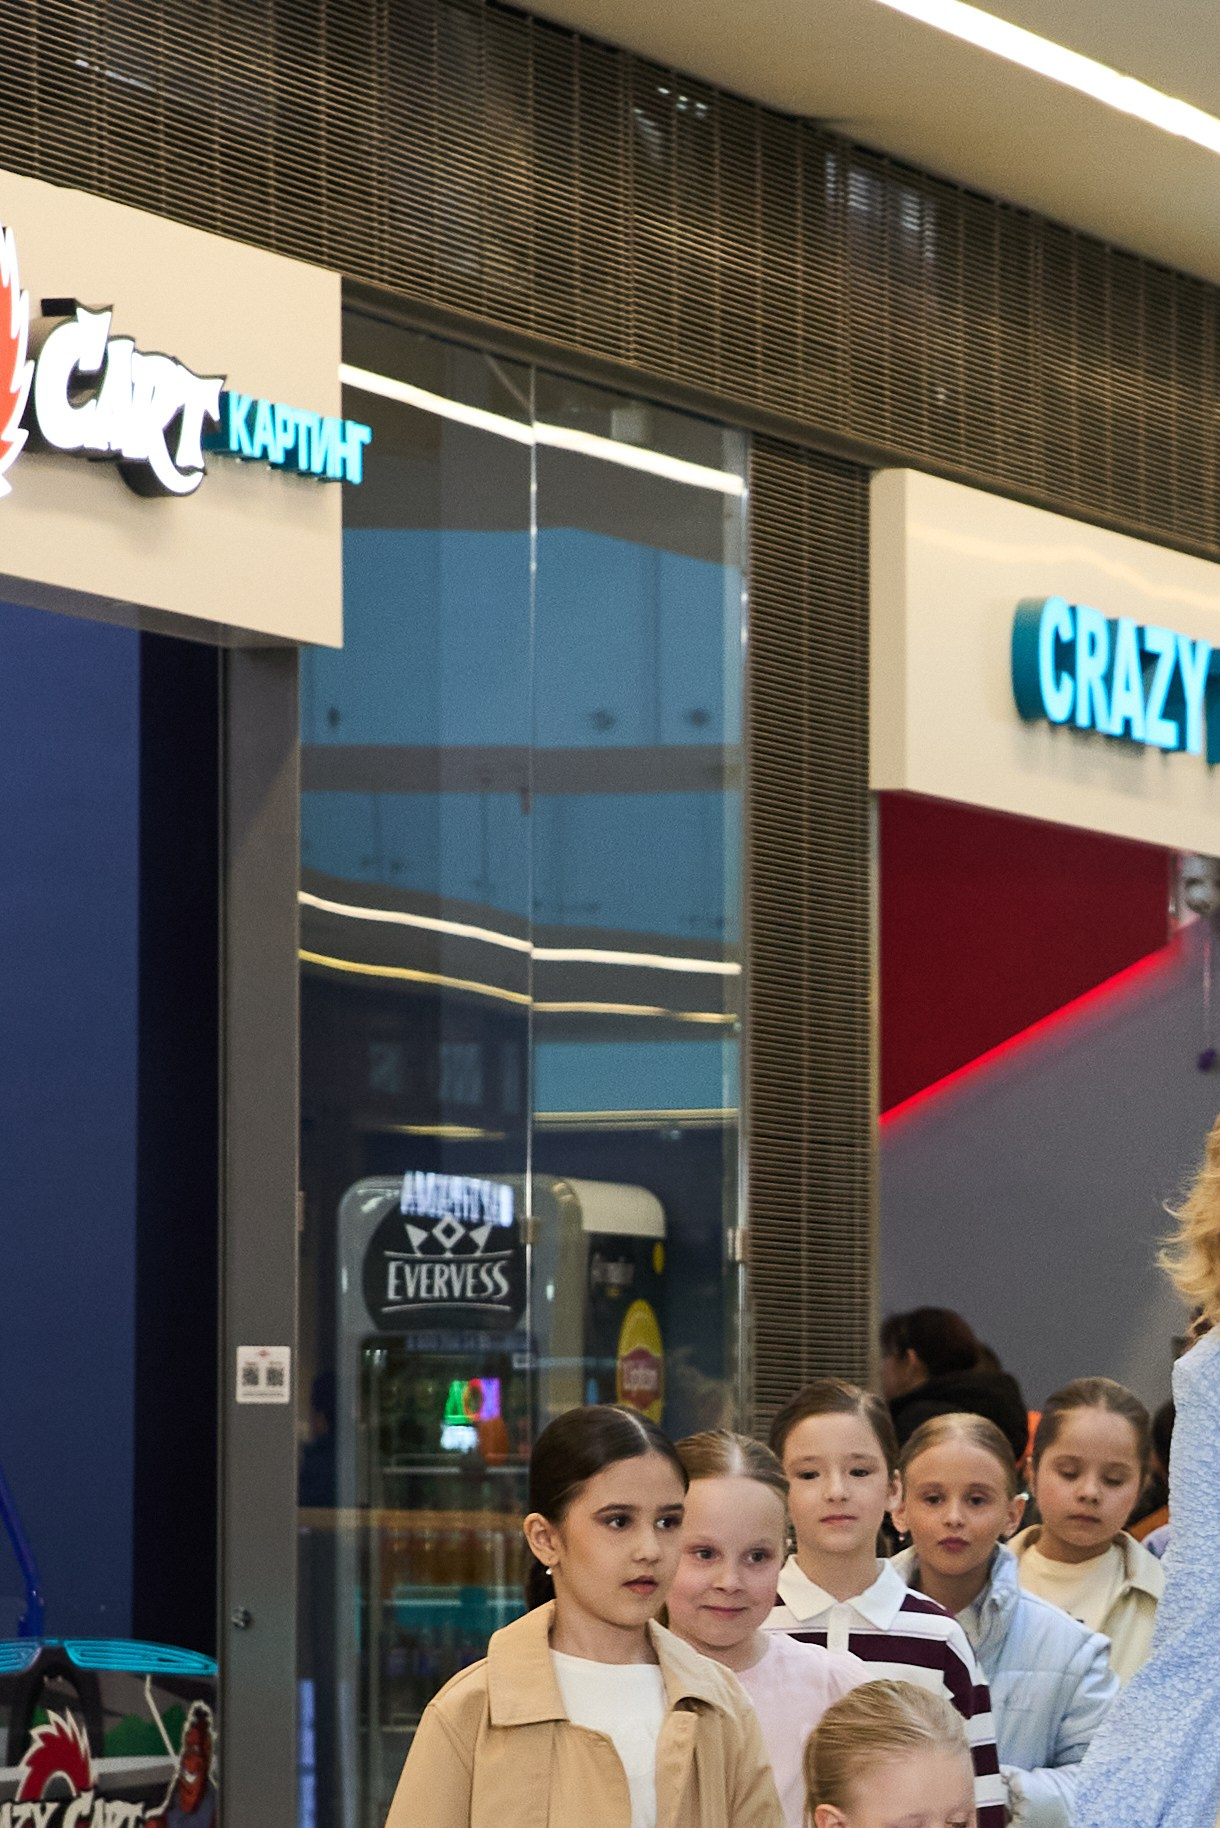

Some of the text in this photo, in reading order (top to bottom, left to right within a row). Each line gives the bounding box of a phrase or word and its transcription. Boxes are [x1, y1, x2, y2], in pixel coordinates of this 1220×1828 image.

[228, 389, 373, 485] КАРТИНГ
[1037, 595, 1212, 756] CRAZY
[387, 1259, 511, 1301] EVERVESS
